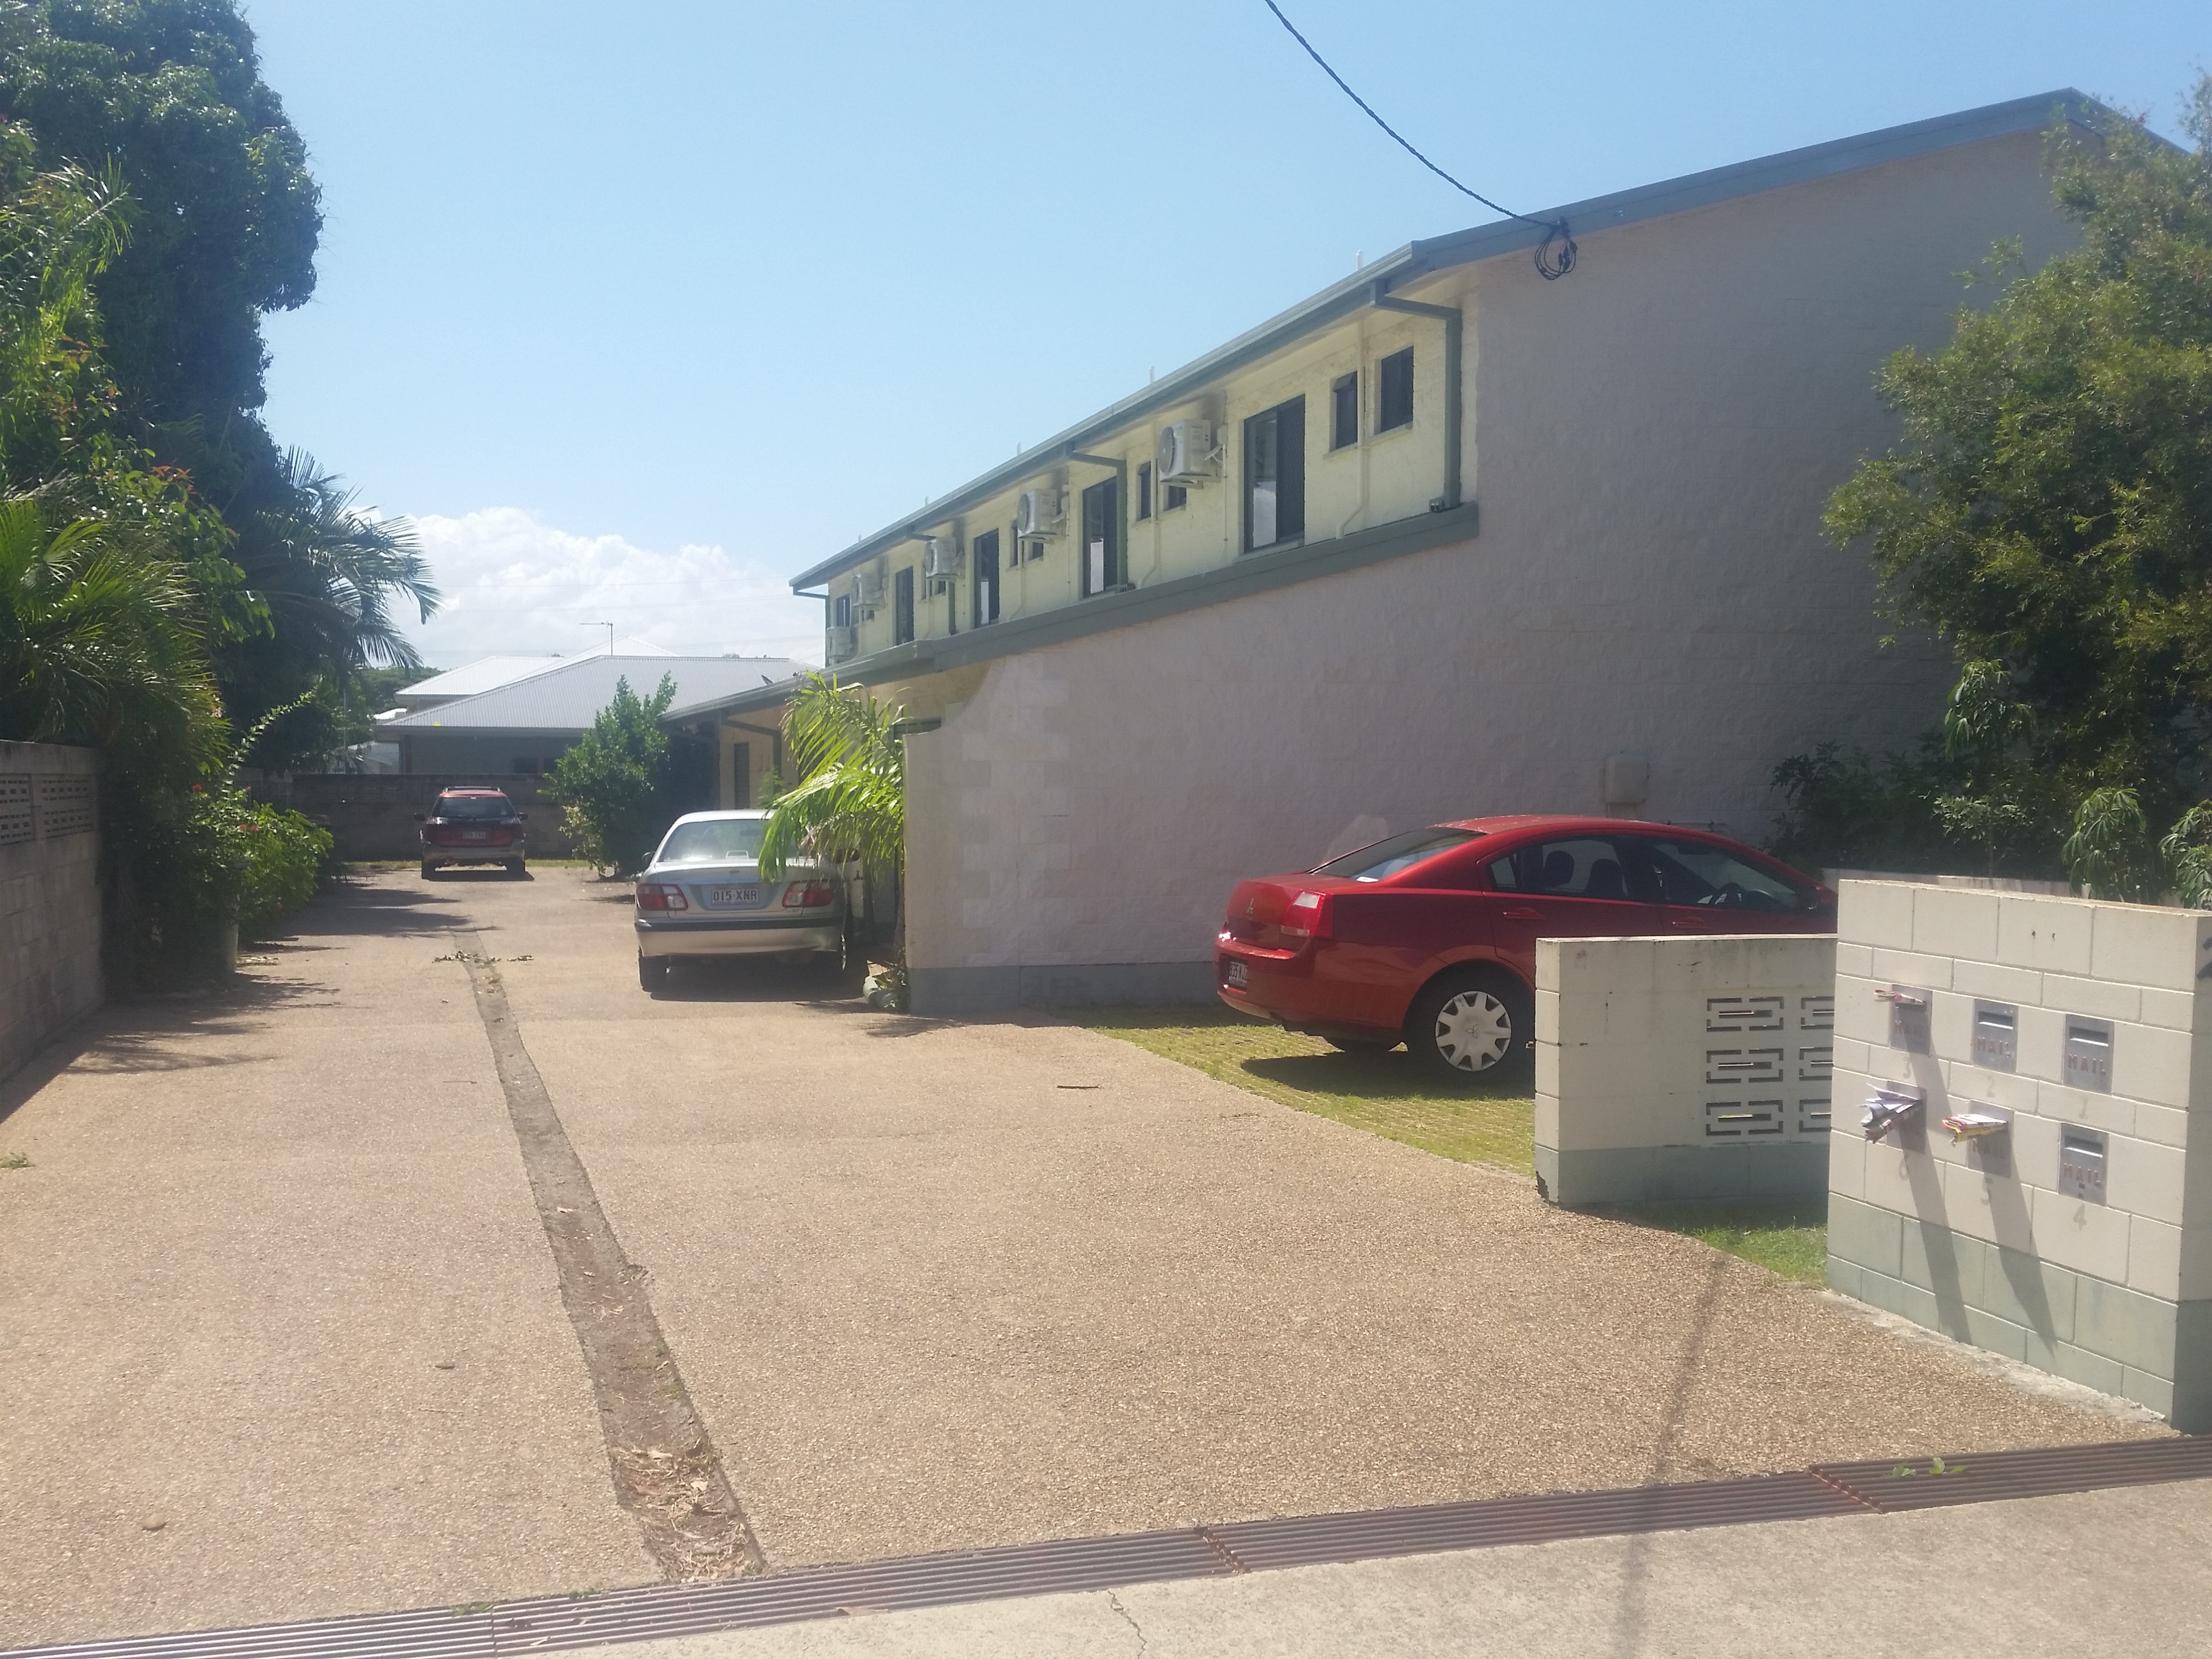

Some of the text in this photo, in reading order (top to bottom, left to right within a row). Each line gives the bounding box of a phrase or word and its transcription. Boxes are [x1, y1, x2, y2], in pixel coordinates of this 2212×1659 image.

[1894, 1020, 1924, 1038] MAIL
[1903, 1056, 1911, 1079] 3
[2068, 1054, 2107, 1075] MAIL
[1987, 1075, 1996, 1098] 2
[2064, 1163, 2102, 1187] MAIL
[2074, 1204, 2088, 1231] 4
